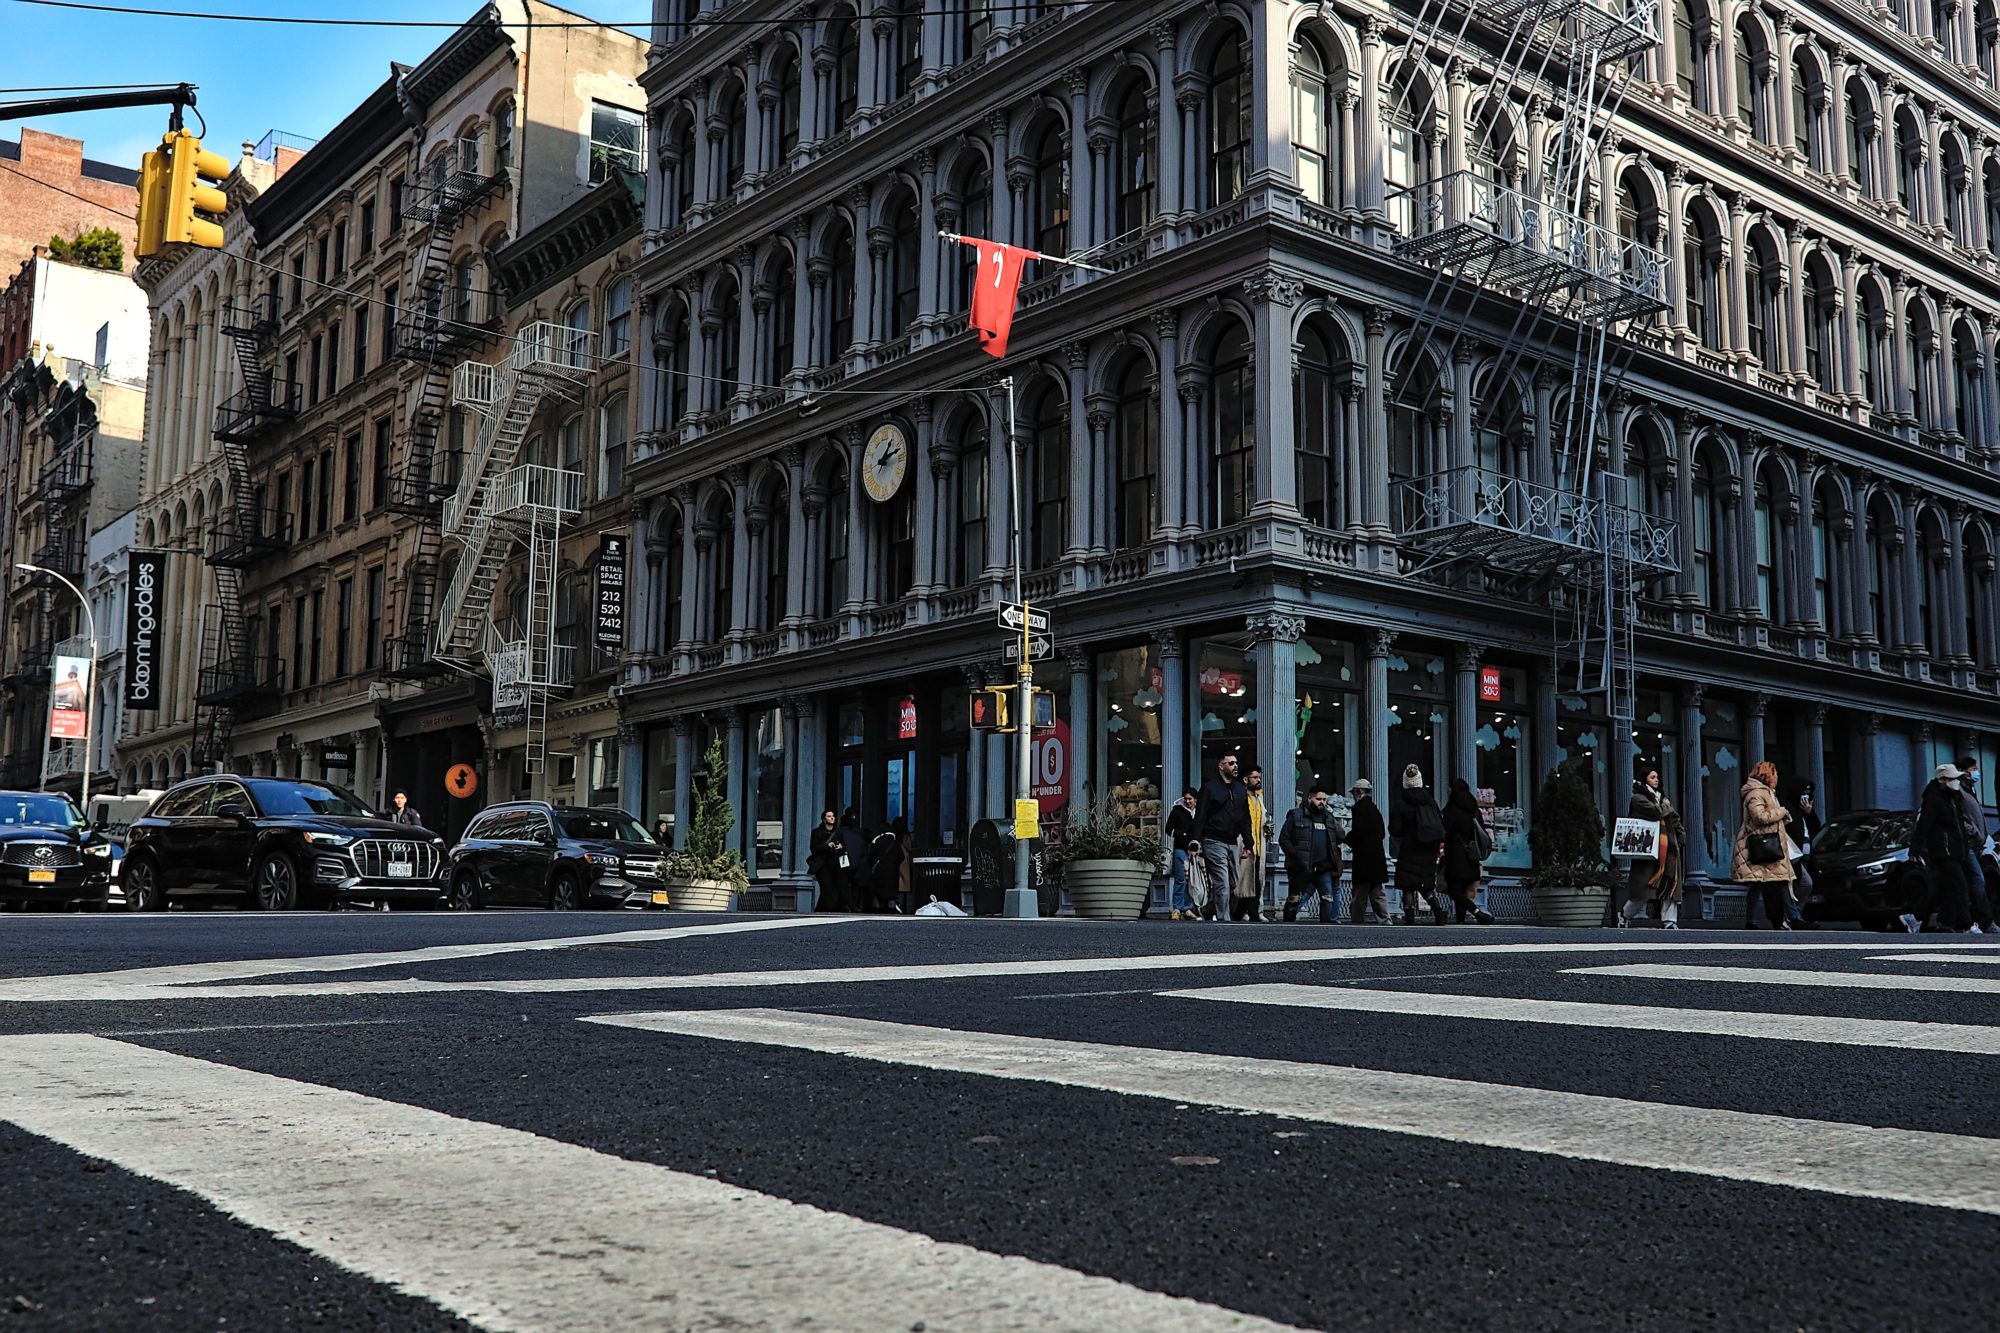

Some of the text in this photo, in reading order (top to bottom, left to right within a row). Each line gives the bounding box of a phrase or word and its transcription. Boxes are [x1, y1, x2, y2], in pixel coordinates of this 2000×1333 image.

[600, 565, 623, 573] RETAIL
[600, 572, 623, 580] SPACE
[602, 591, 620, 602] 212
[601, 604, 620, 615] 529
[599, 617, 621, 629] 7412
[1006, 610, 1043, 628] ONE WAY
[1030, 642, 1045, 654] WAY
[1484, 675, 1499, 685] MINI
[901, 707, 916, 719] MIN
